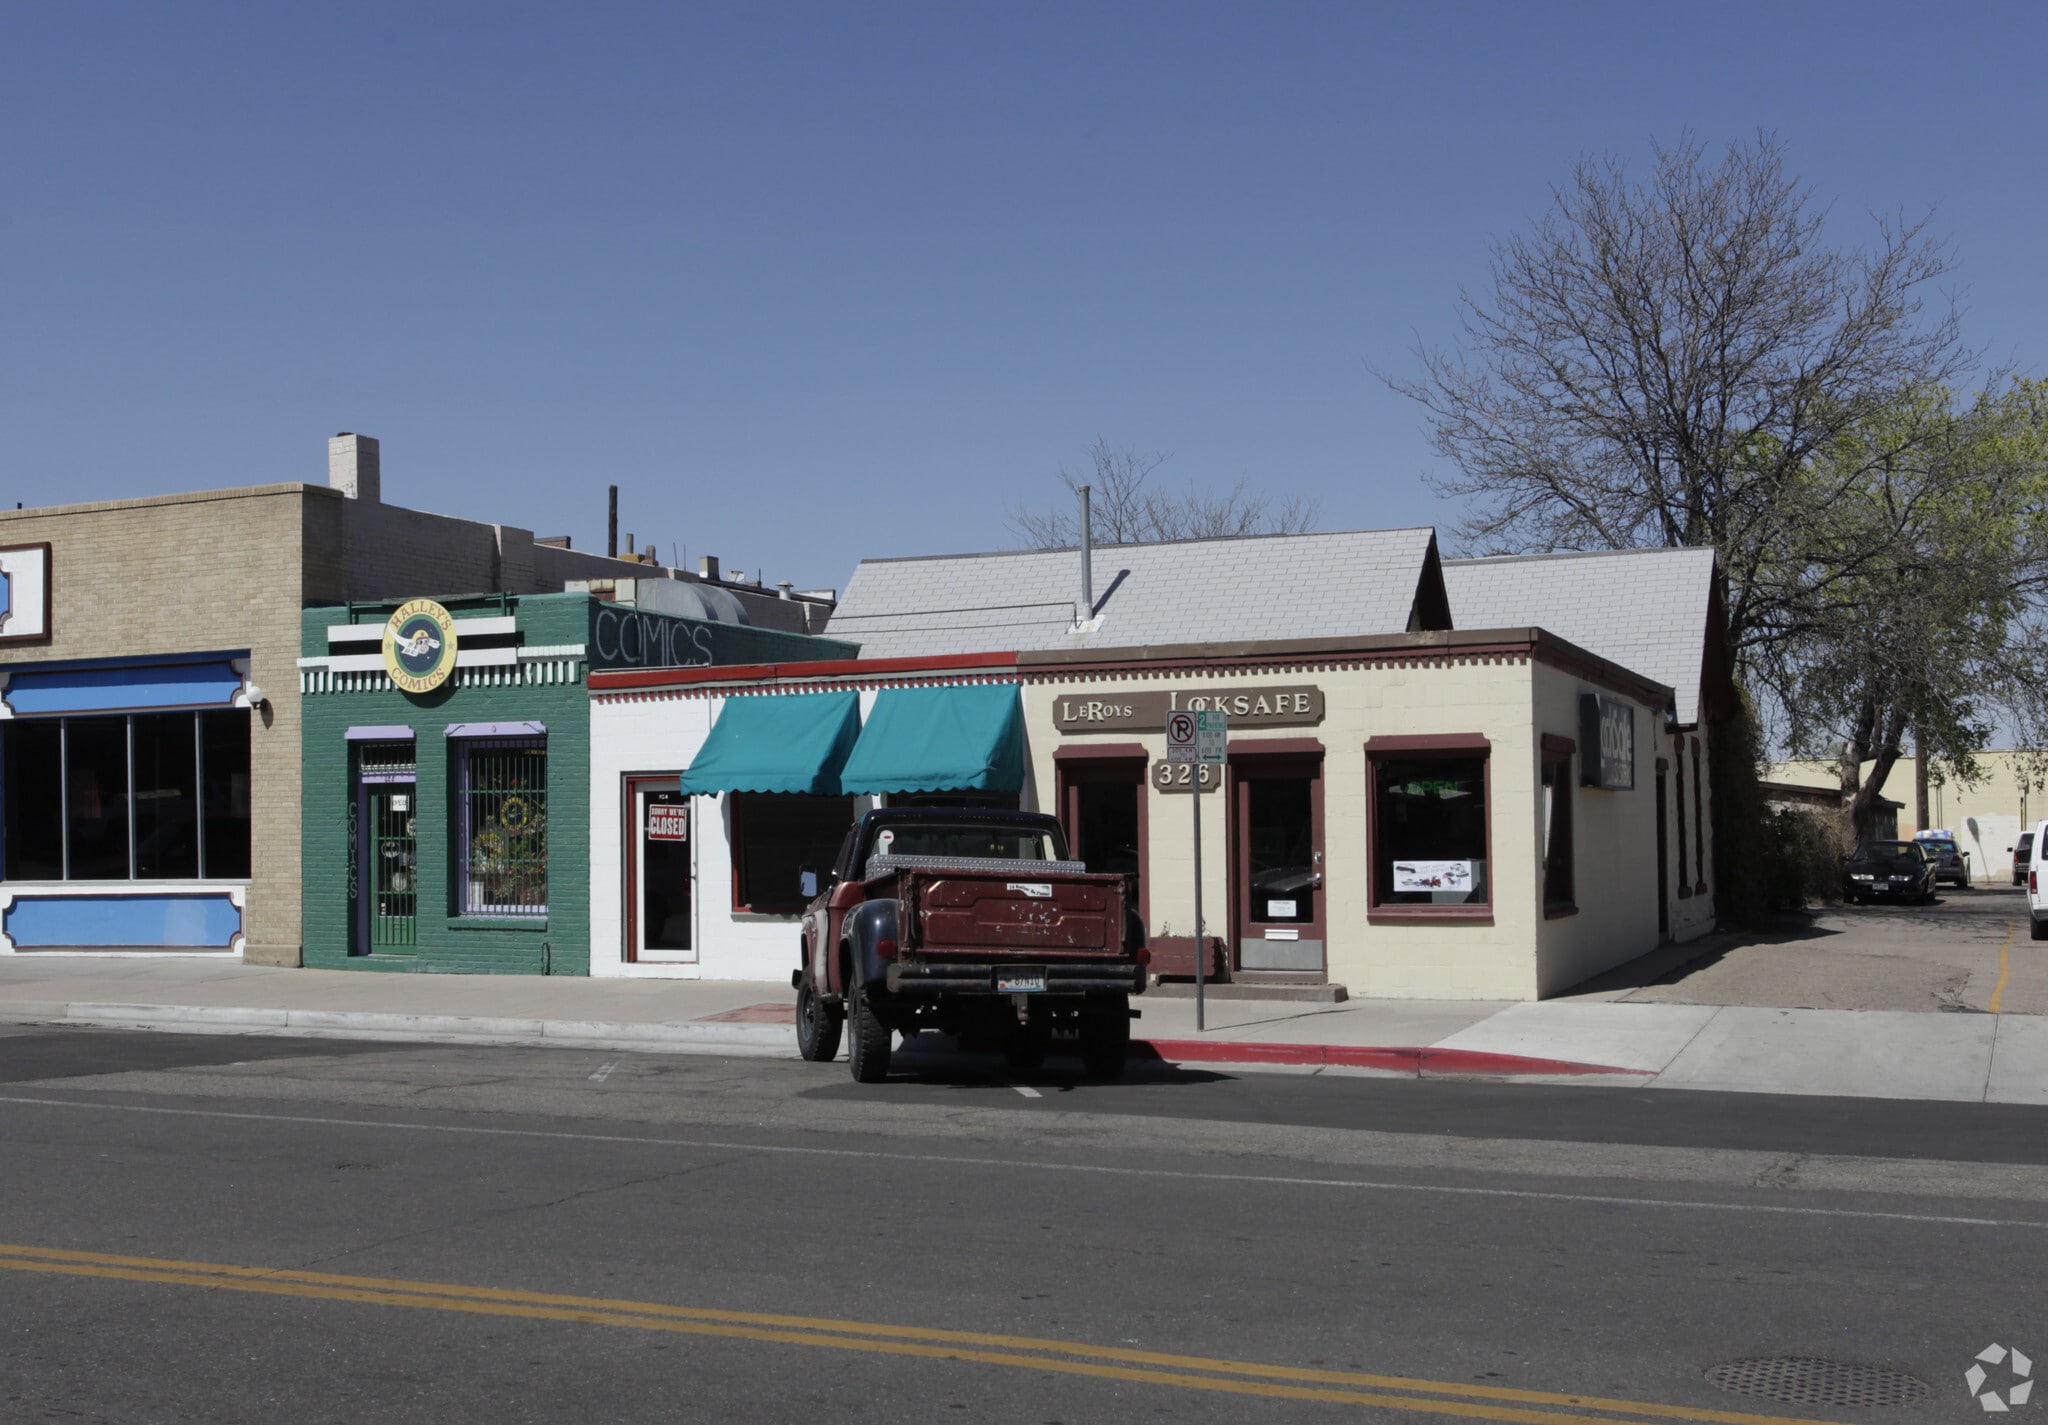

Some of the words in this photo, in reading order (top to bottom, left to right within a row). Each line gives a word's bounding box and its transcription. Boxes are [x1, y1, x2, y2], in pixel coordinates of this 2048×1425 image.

[391, 601, 452, 631] HALLEY'S
[596, 609, 712, 667] COMICS
[391, 667, 446, 691] COMICS
[1199, 714, 1206, 728] 2
[1159, 763, 1210, 785] 326
[651, 807, 668, 815] SORRY
[651, 816, 685, 836] CLOSED
[348, 802, 358, 899] COMICS
